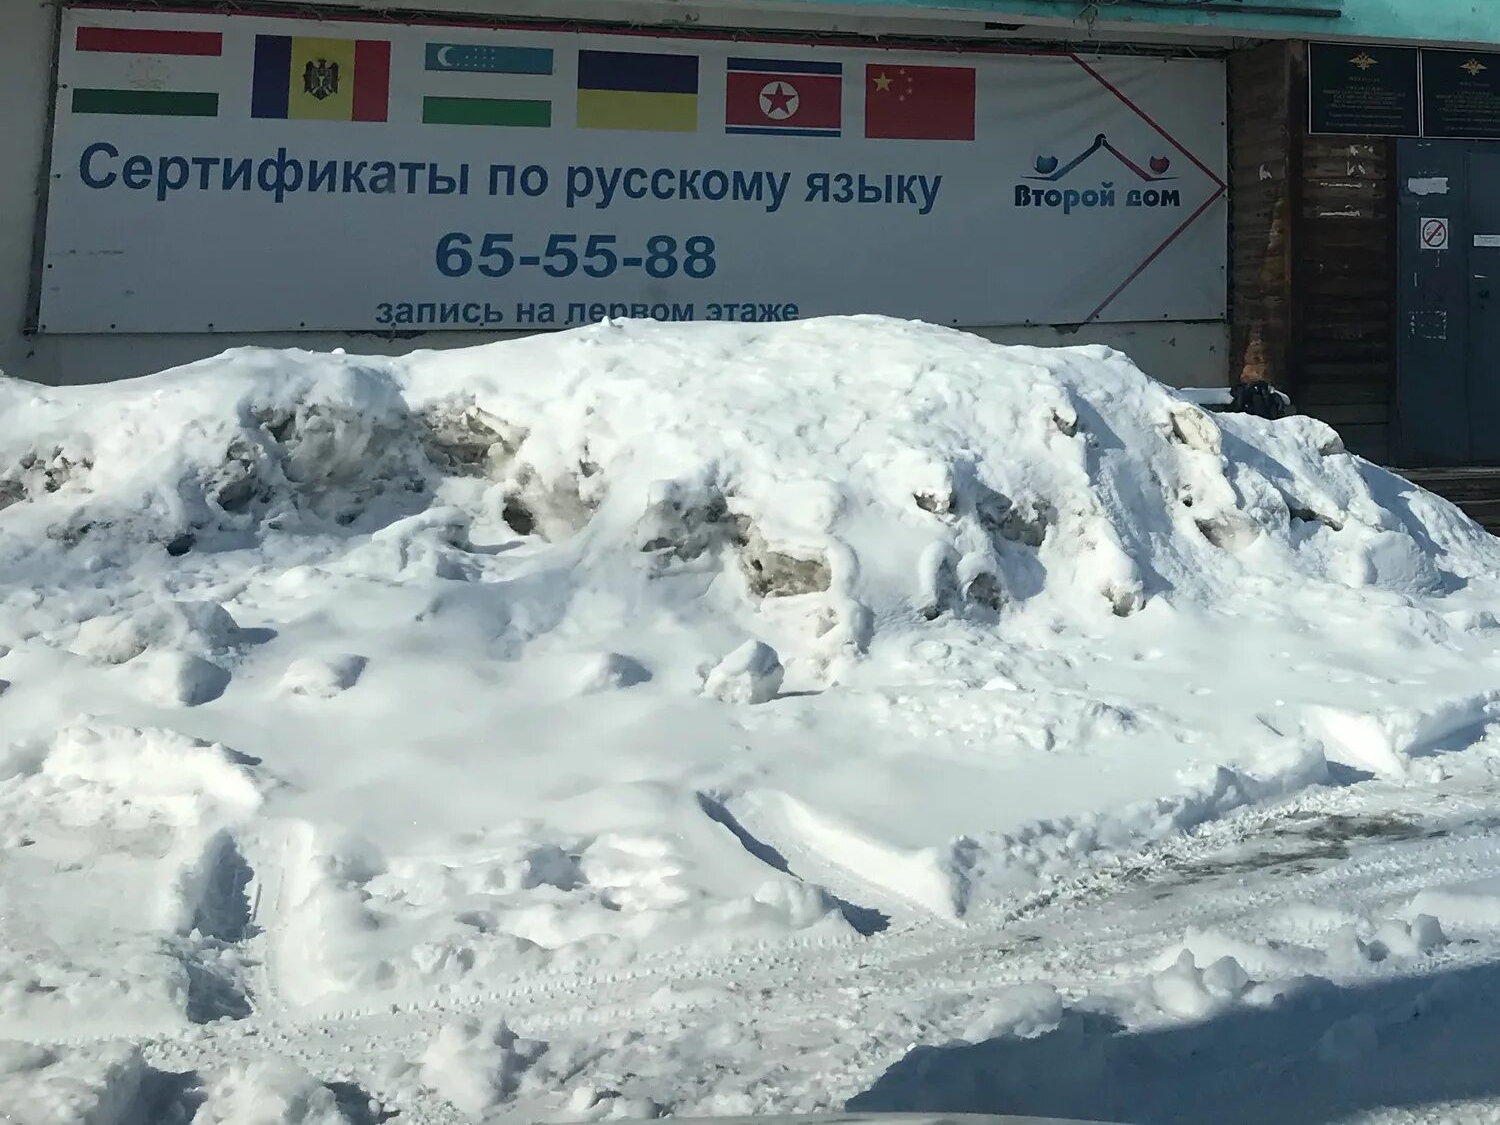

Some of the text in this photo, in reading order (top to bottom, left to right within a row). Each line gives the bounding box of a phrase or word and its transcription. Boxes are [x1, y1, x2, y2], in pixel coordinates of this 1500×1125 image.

[78, 142, 942, 215] Сертификаты по русскому языку
[1014, 181, 1181, 215] Второй дом
[435, 231, 717, 279] 65-55-88
[375, 302, 800, 323] запись на первом этаже
